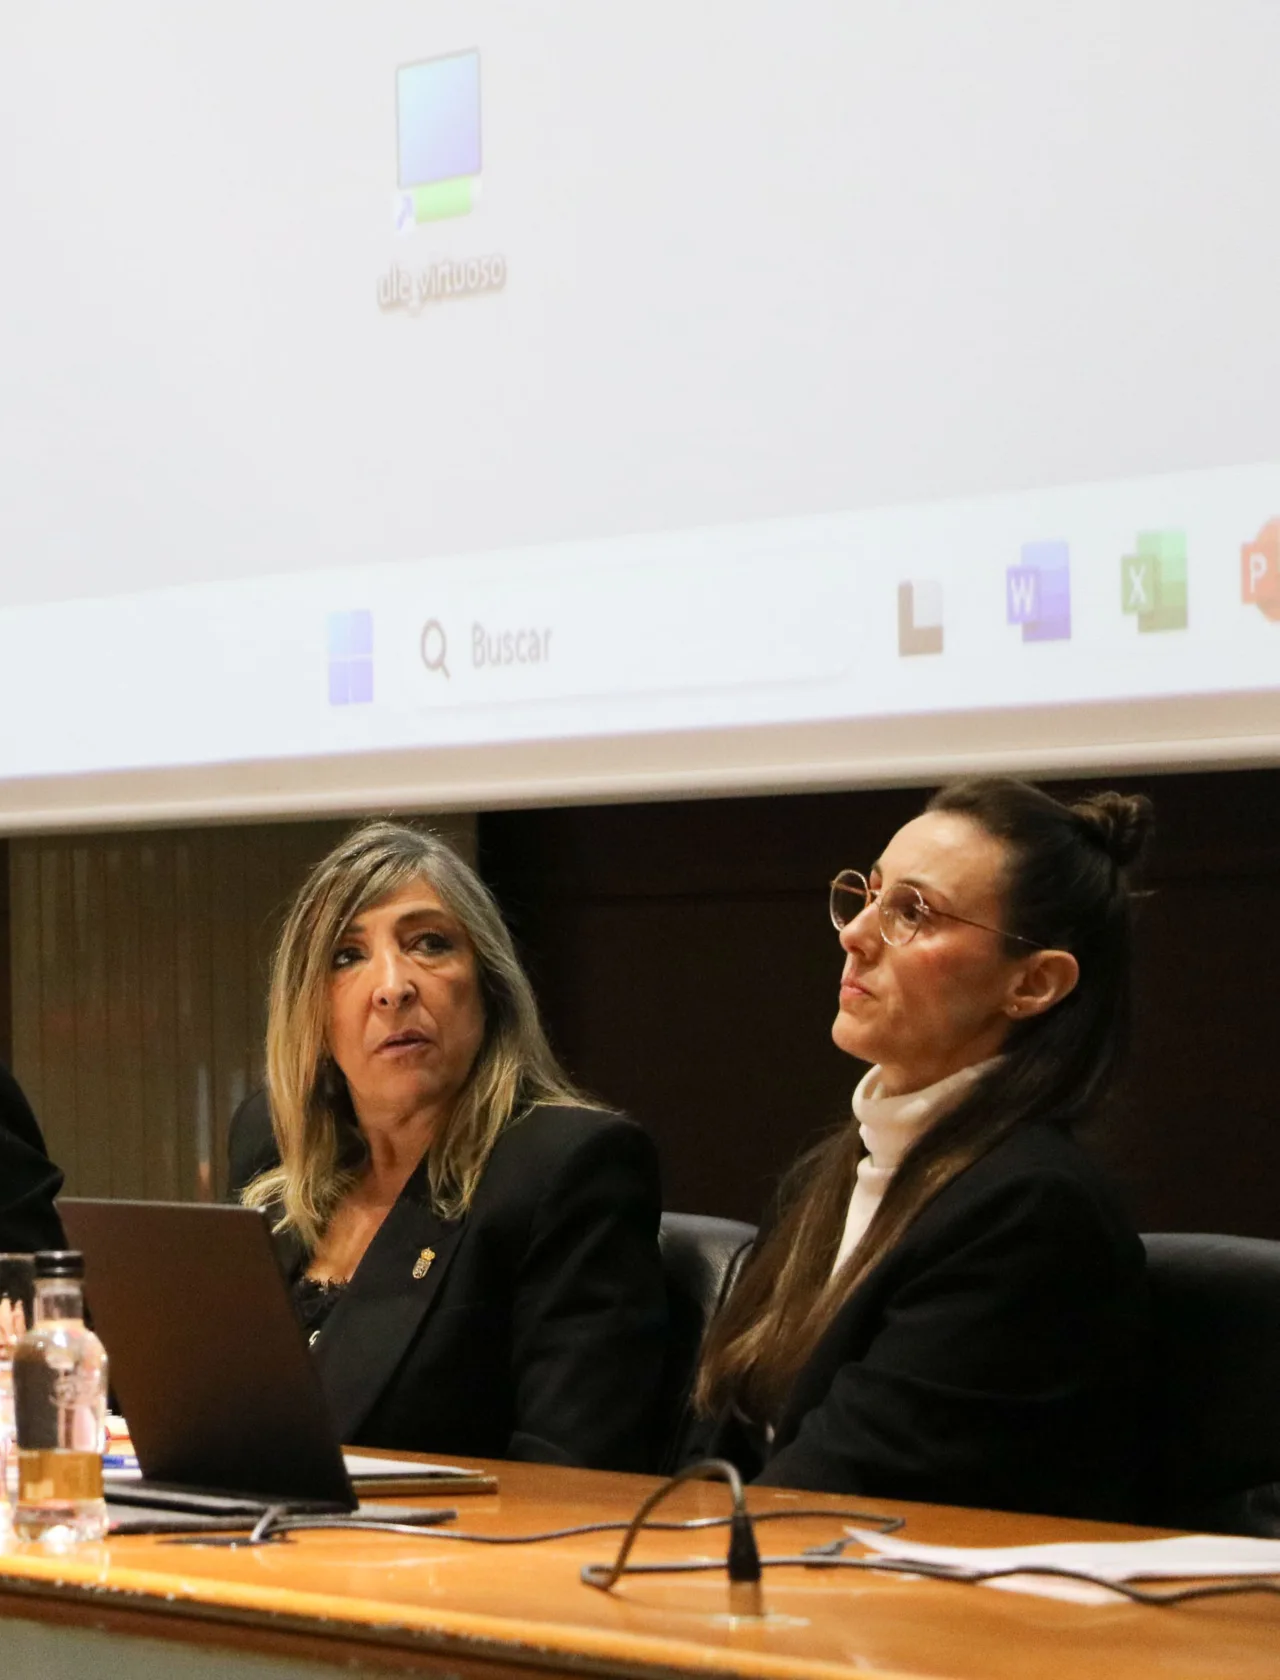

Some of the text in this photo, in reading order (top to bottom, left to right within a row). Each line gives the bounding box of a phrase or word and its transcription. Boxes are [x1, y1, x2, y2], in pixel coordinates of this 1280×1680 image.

[1128, 564, 1147, 607] X
[1249, 552, 1268, 594] P
[1010, 573, 1036, 617] W
[471, 621, 552, 669] Buscar
